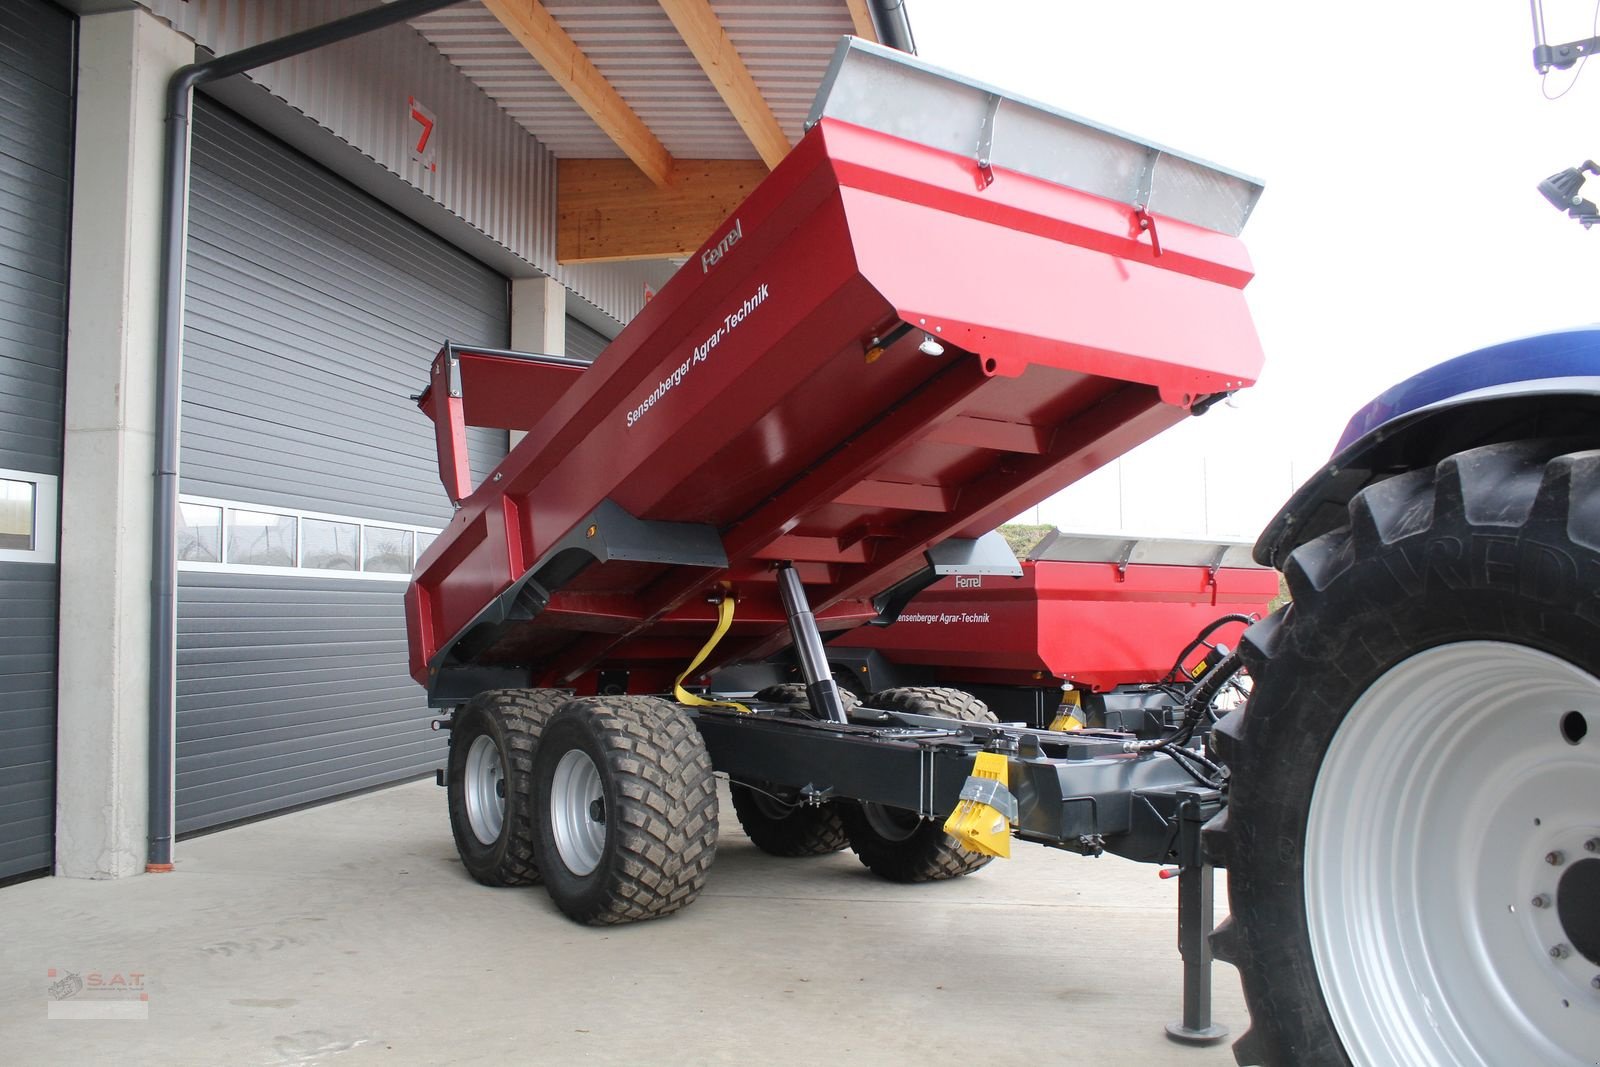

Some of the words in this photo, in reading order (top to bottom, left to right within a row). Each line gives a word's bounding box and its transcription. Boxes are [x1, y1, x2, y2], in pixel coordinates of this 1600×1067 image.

[411, 108, 434, 154] 7
[700, 217, 743, 275] Ferrel
[626, 357, 691, 428] Sensenberger
[692, 282, 770, 366] Agrar-Technik
[955, 574, 982, 589] Ferrel
[896, 613, 939, 625] ensenberger
[939, 612, 990, 625] Agrar-Technik
